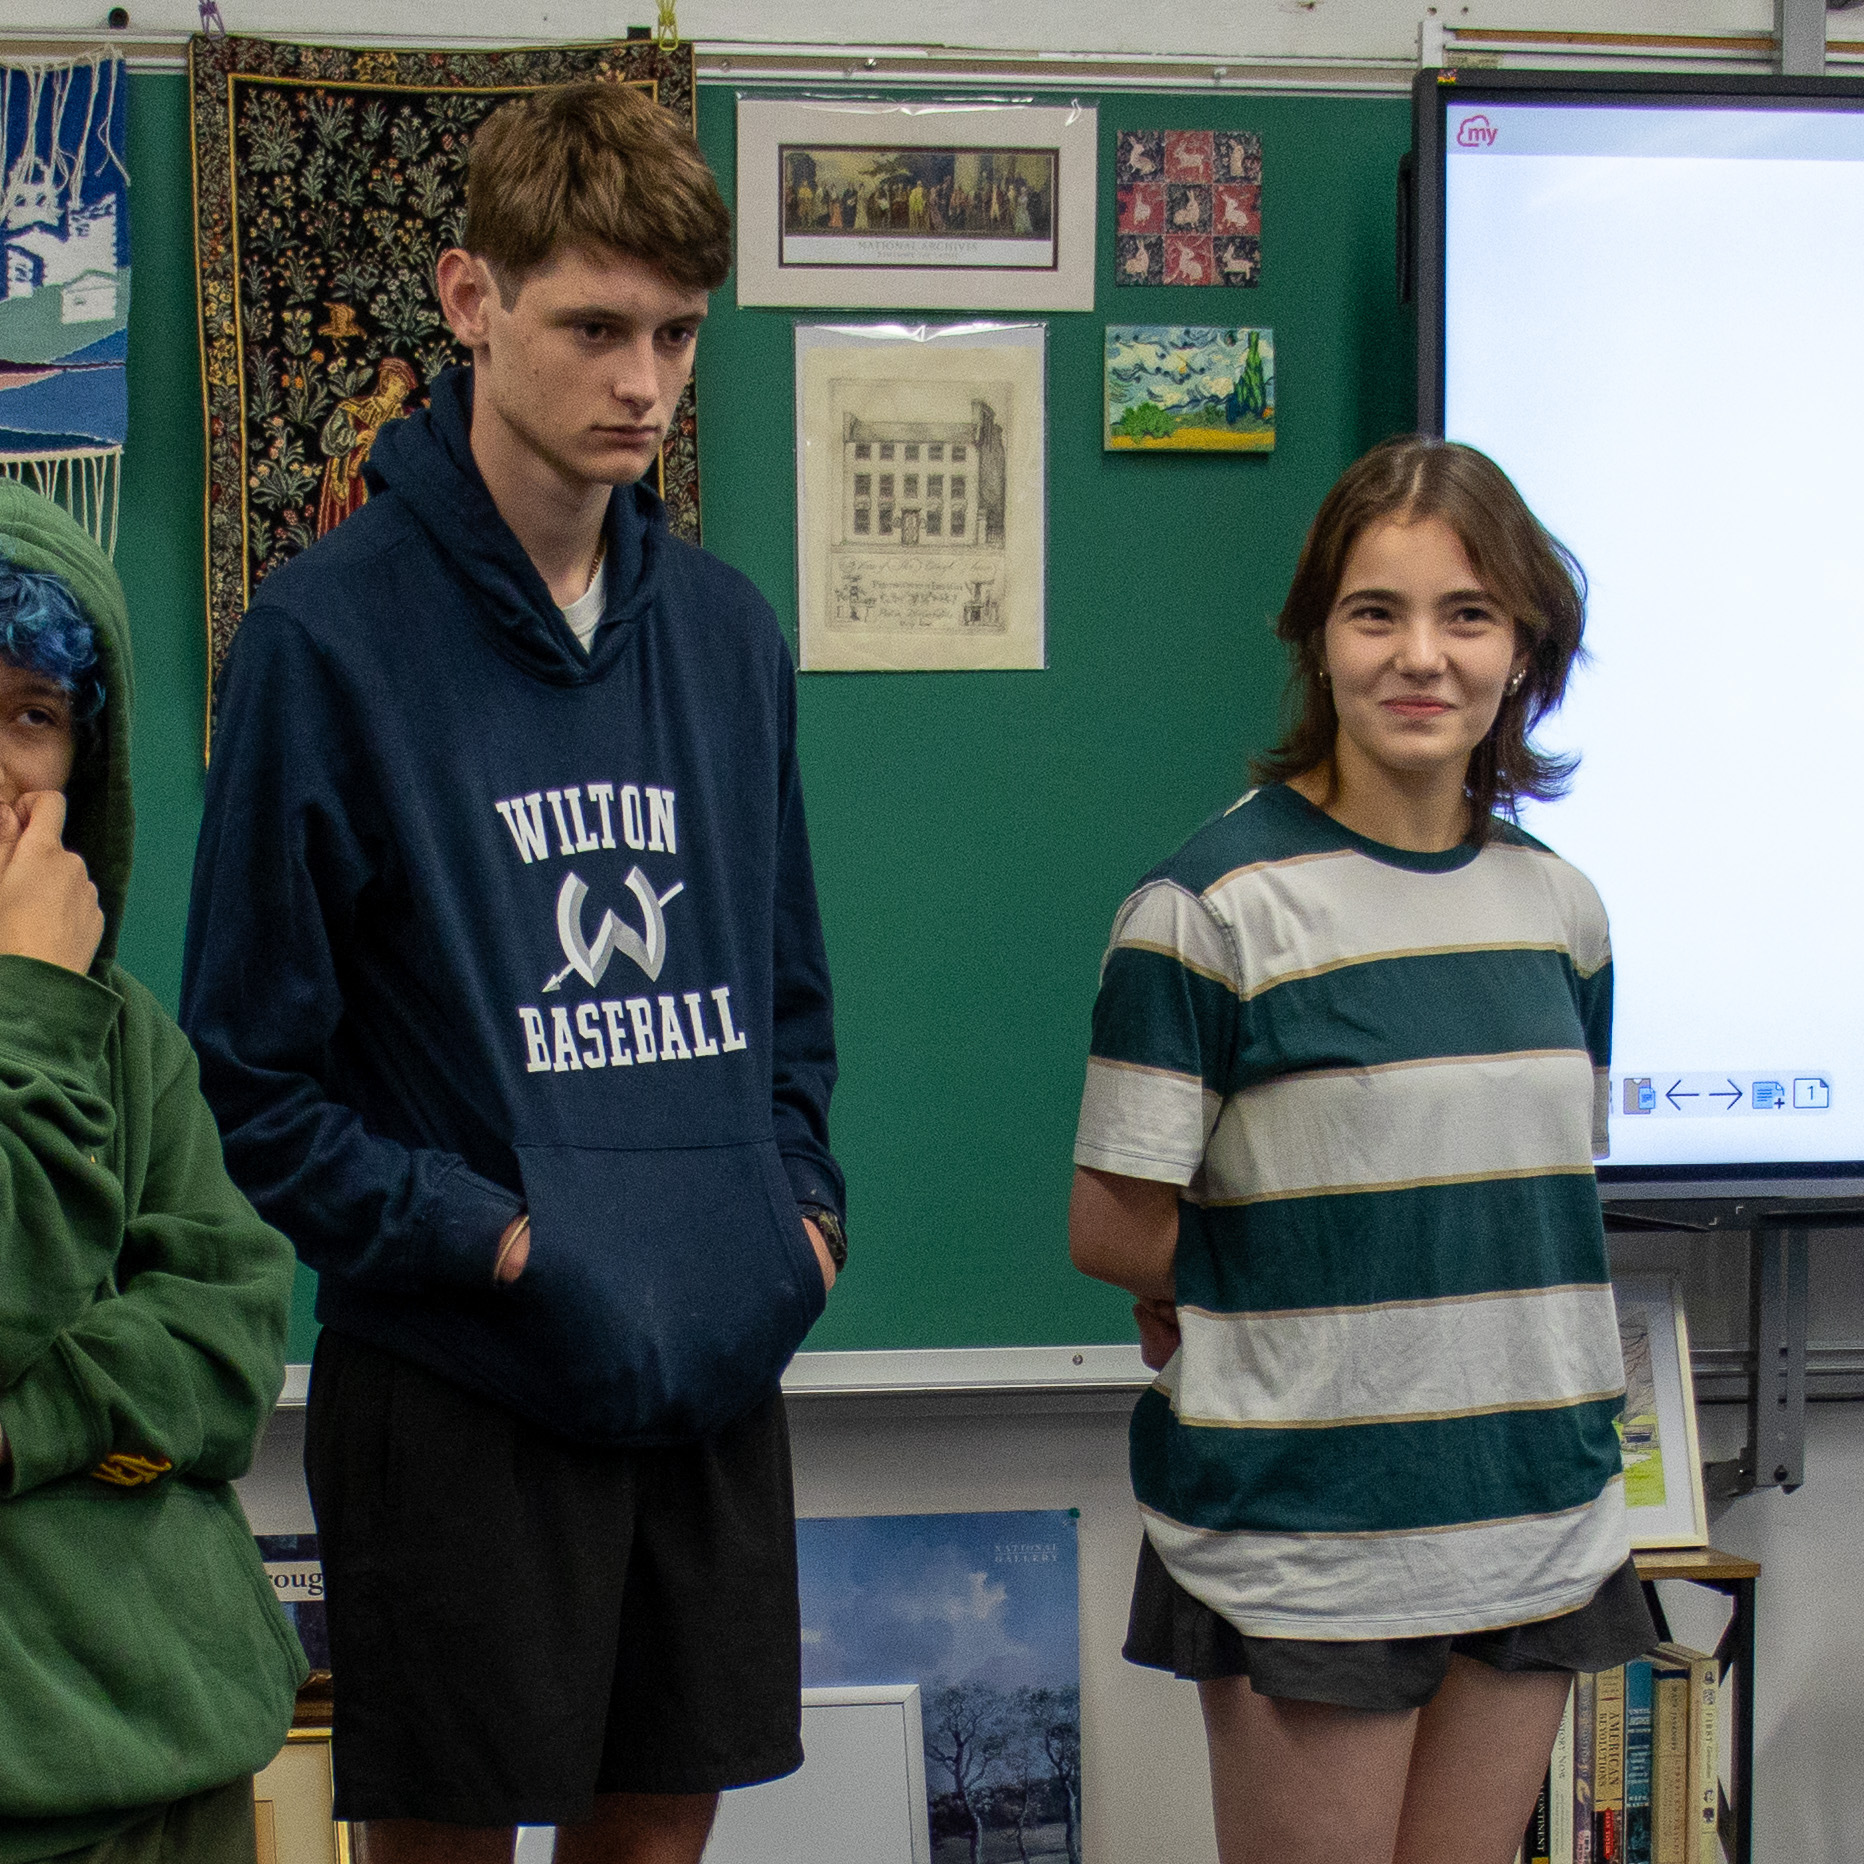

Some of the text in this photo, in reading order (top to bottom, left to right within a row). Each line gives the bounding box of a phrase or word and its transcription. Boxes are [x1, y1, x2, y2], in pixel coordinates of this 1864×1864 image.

[495, 783, 677, 864] WILTON
[518, 986, 747, 1073] BASEBALL
[269, 1572, 324, 1596] oug
[1598, 1712, 1607, 1787] REVOLUTIONS
[1608, 1711, 1620, 1785] AMERICAN
